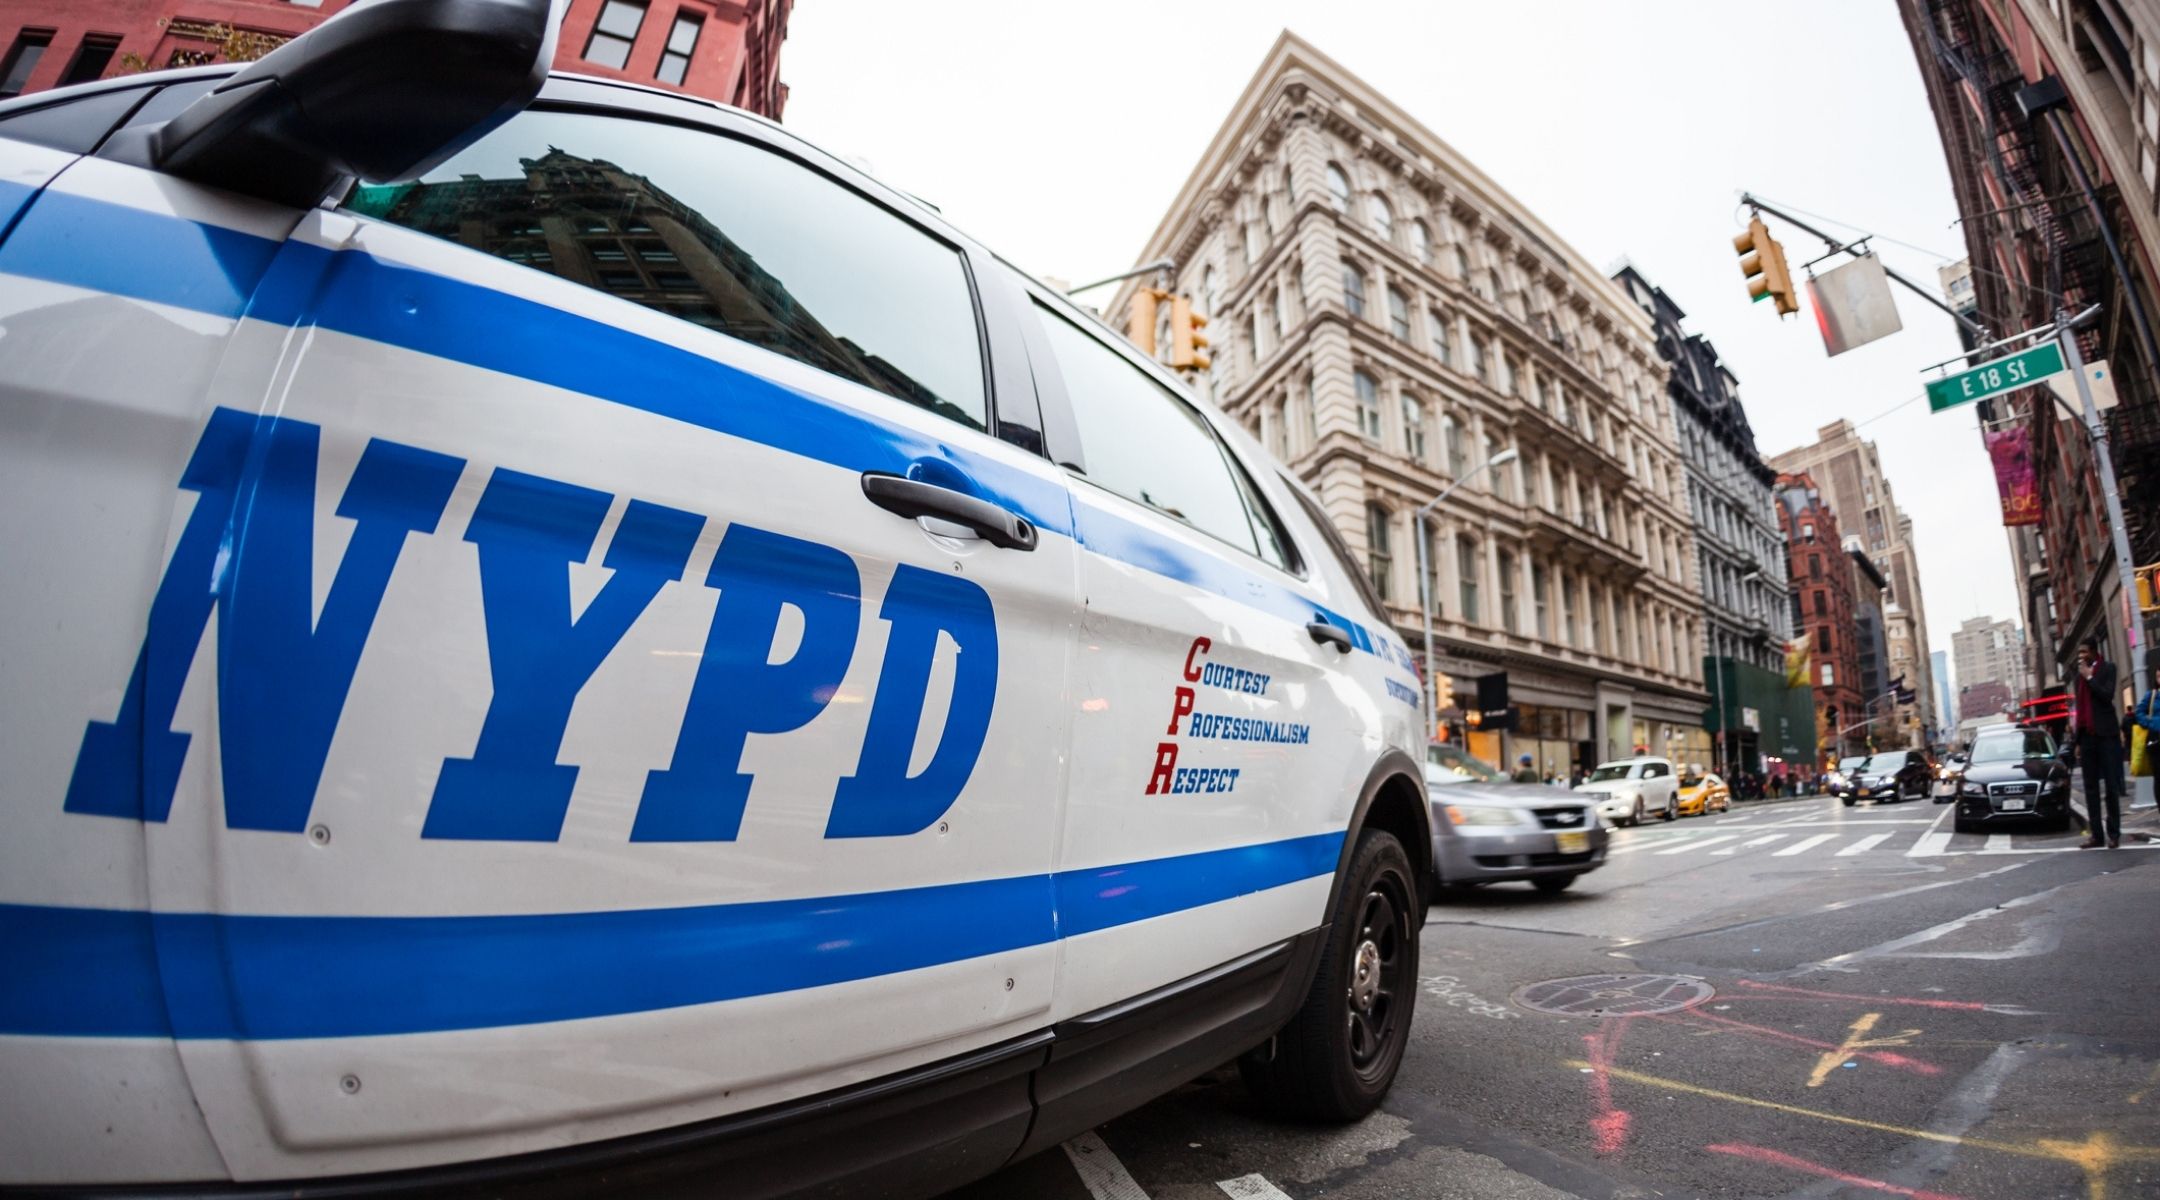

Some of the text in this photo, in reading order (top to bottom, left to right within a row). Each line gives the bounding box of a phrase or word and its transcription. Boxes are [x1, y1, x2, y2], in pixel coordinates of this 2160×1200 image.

[1961, 359, 2029, 397] E 18 St
[64, 406, 999, 843] NYPD
[1183, 636, 1270, 695] COURTESY
[1167, 686, 1310, 744] PROFESSIONALISM
[1145, 742, 1240, 795] RESPECT
